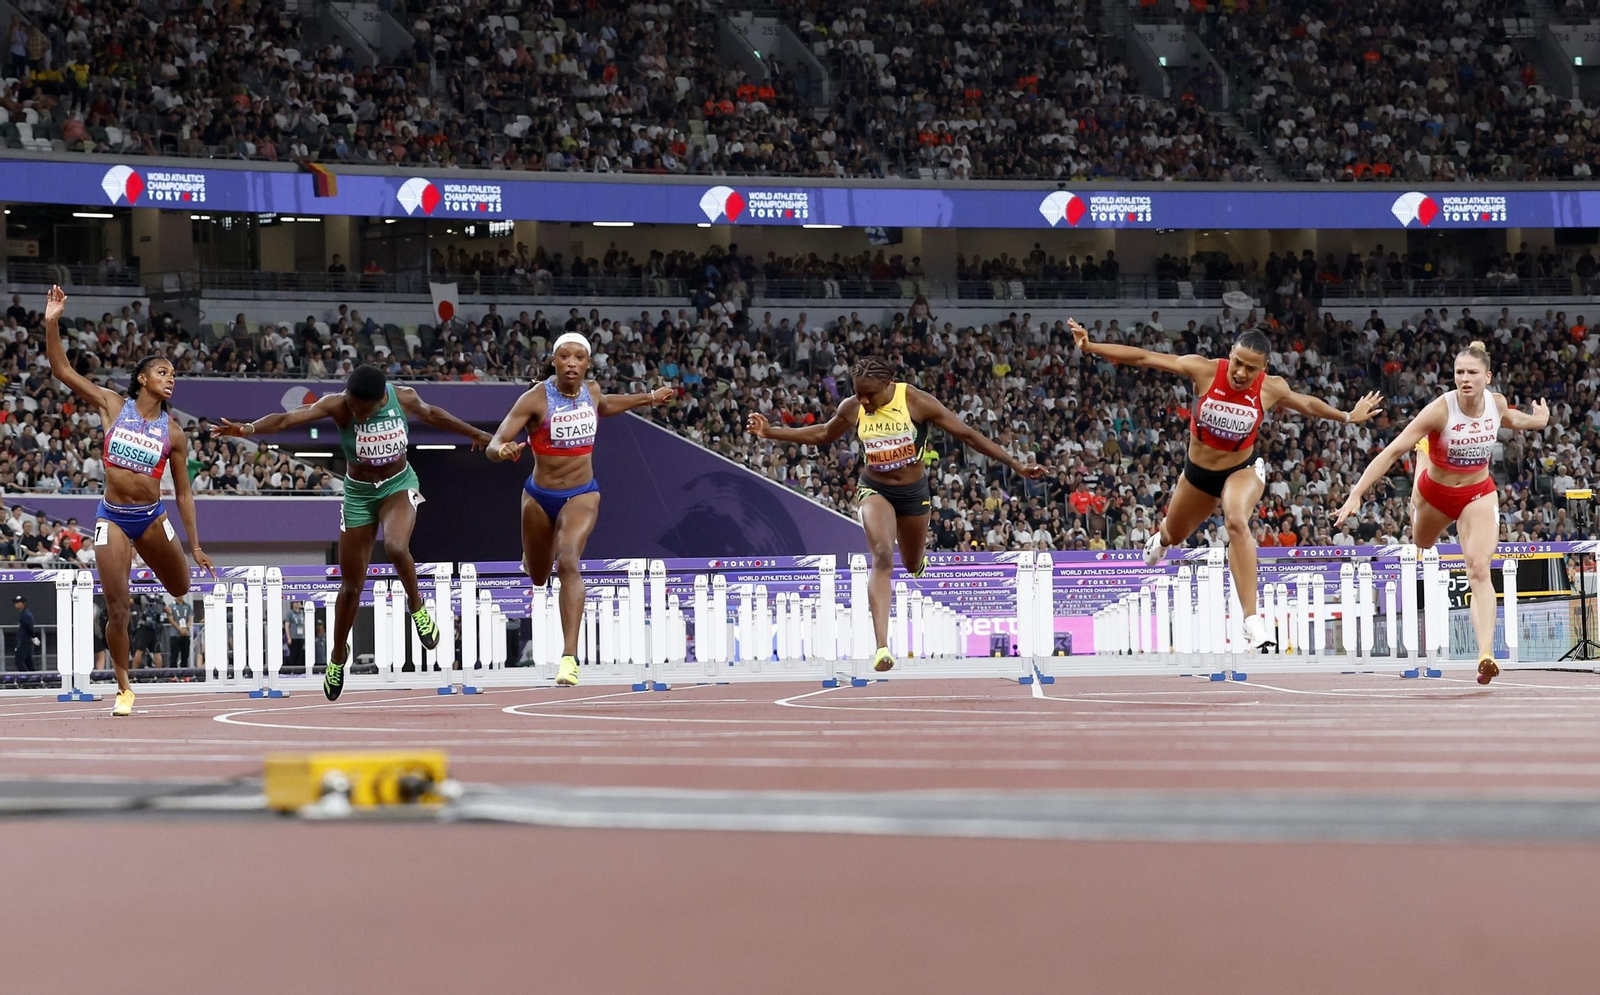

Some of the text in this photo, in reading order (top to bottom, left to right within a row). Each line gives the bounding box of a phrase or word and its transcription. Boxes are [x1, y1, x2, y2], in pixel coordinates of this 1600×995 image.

[762, 26, 780, 35] 255
[147, 173, 205, 183] WORLD ATHLETICS
[147, 181, 205, 192] CHAMPIONSHIPS
[468, 185, 501, 193] ATHLETICS
[444, 193, 501, 202] CHAMPIONSHIPS
[749, 200, 808, 209] CHAMPIONSHIPS
[552, 410, 594, 422] HONDA
[1204, 402, 1256, 419] HONDA
[354, 418, 404, 433] NIGERIA
[863, 422, 910, 433] JAMAICA
[1202, 412, 1253, 432] KAMBUNDJI
[1452, 424, 1466, 432] 4F
[358, 430, 404, 442] HONDA
[556, 422, 595, 438] STARK
[114, 430, 160, 452] HONDA
[865, 436, 911, 449] HONDA
[1451, 435, 1495, 445] HONDA
[110, 442, 154, 465] RUSSELL
[360, 439, 406, 456] AMUSAN
[868, 444, 913, 463] WILLIAMS
